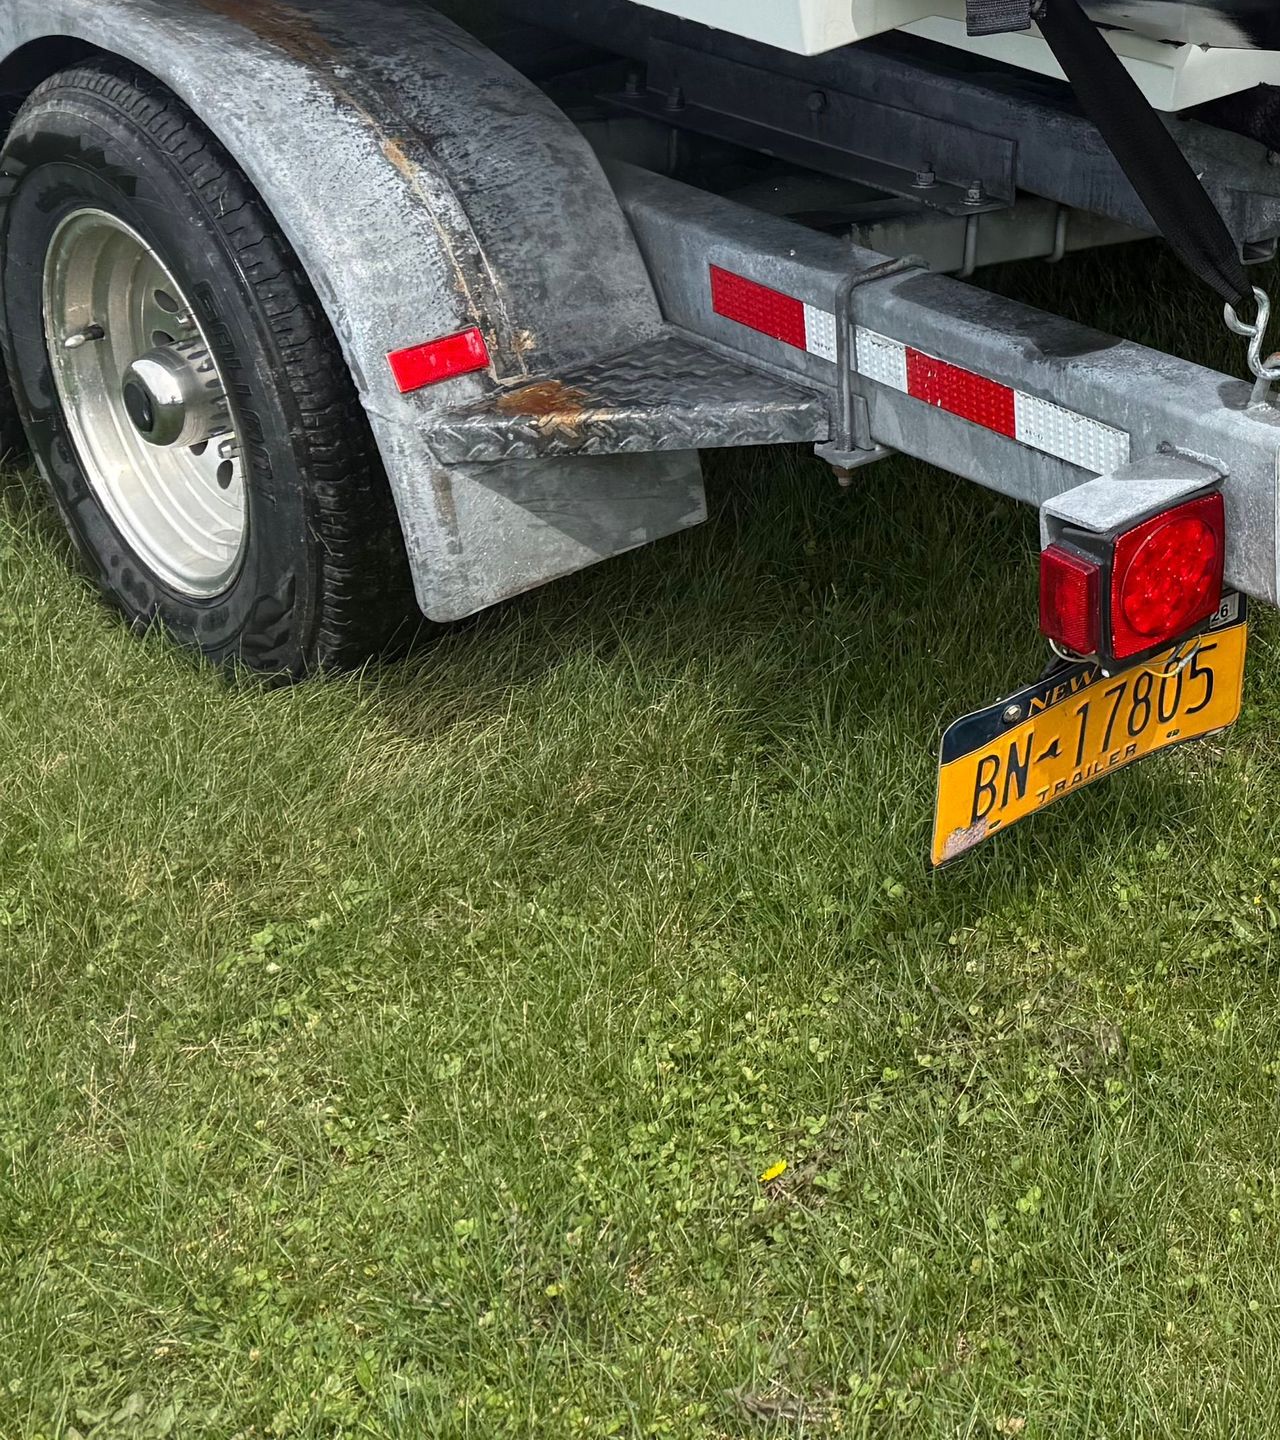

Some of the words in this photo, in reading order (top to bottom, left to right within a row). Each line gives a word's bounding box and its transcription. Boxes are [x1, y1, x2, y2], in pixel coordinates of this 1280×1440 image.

[1028, 664, 1098, 717] NEW
[971, 732, 1034, 825] BN
[1075, 642, 1218, 768] 17805
[1037, 743, 1137, 803] TRAILER
